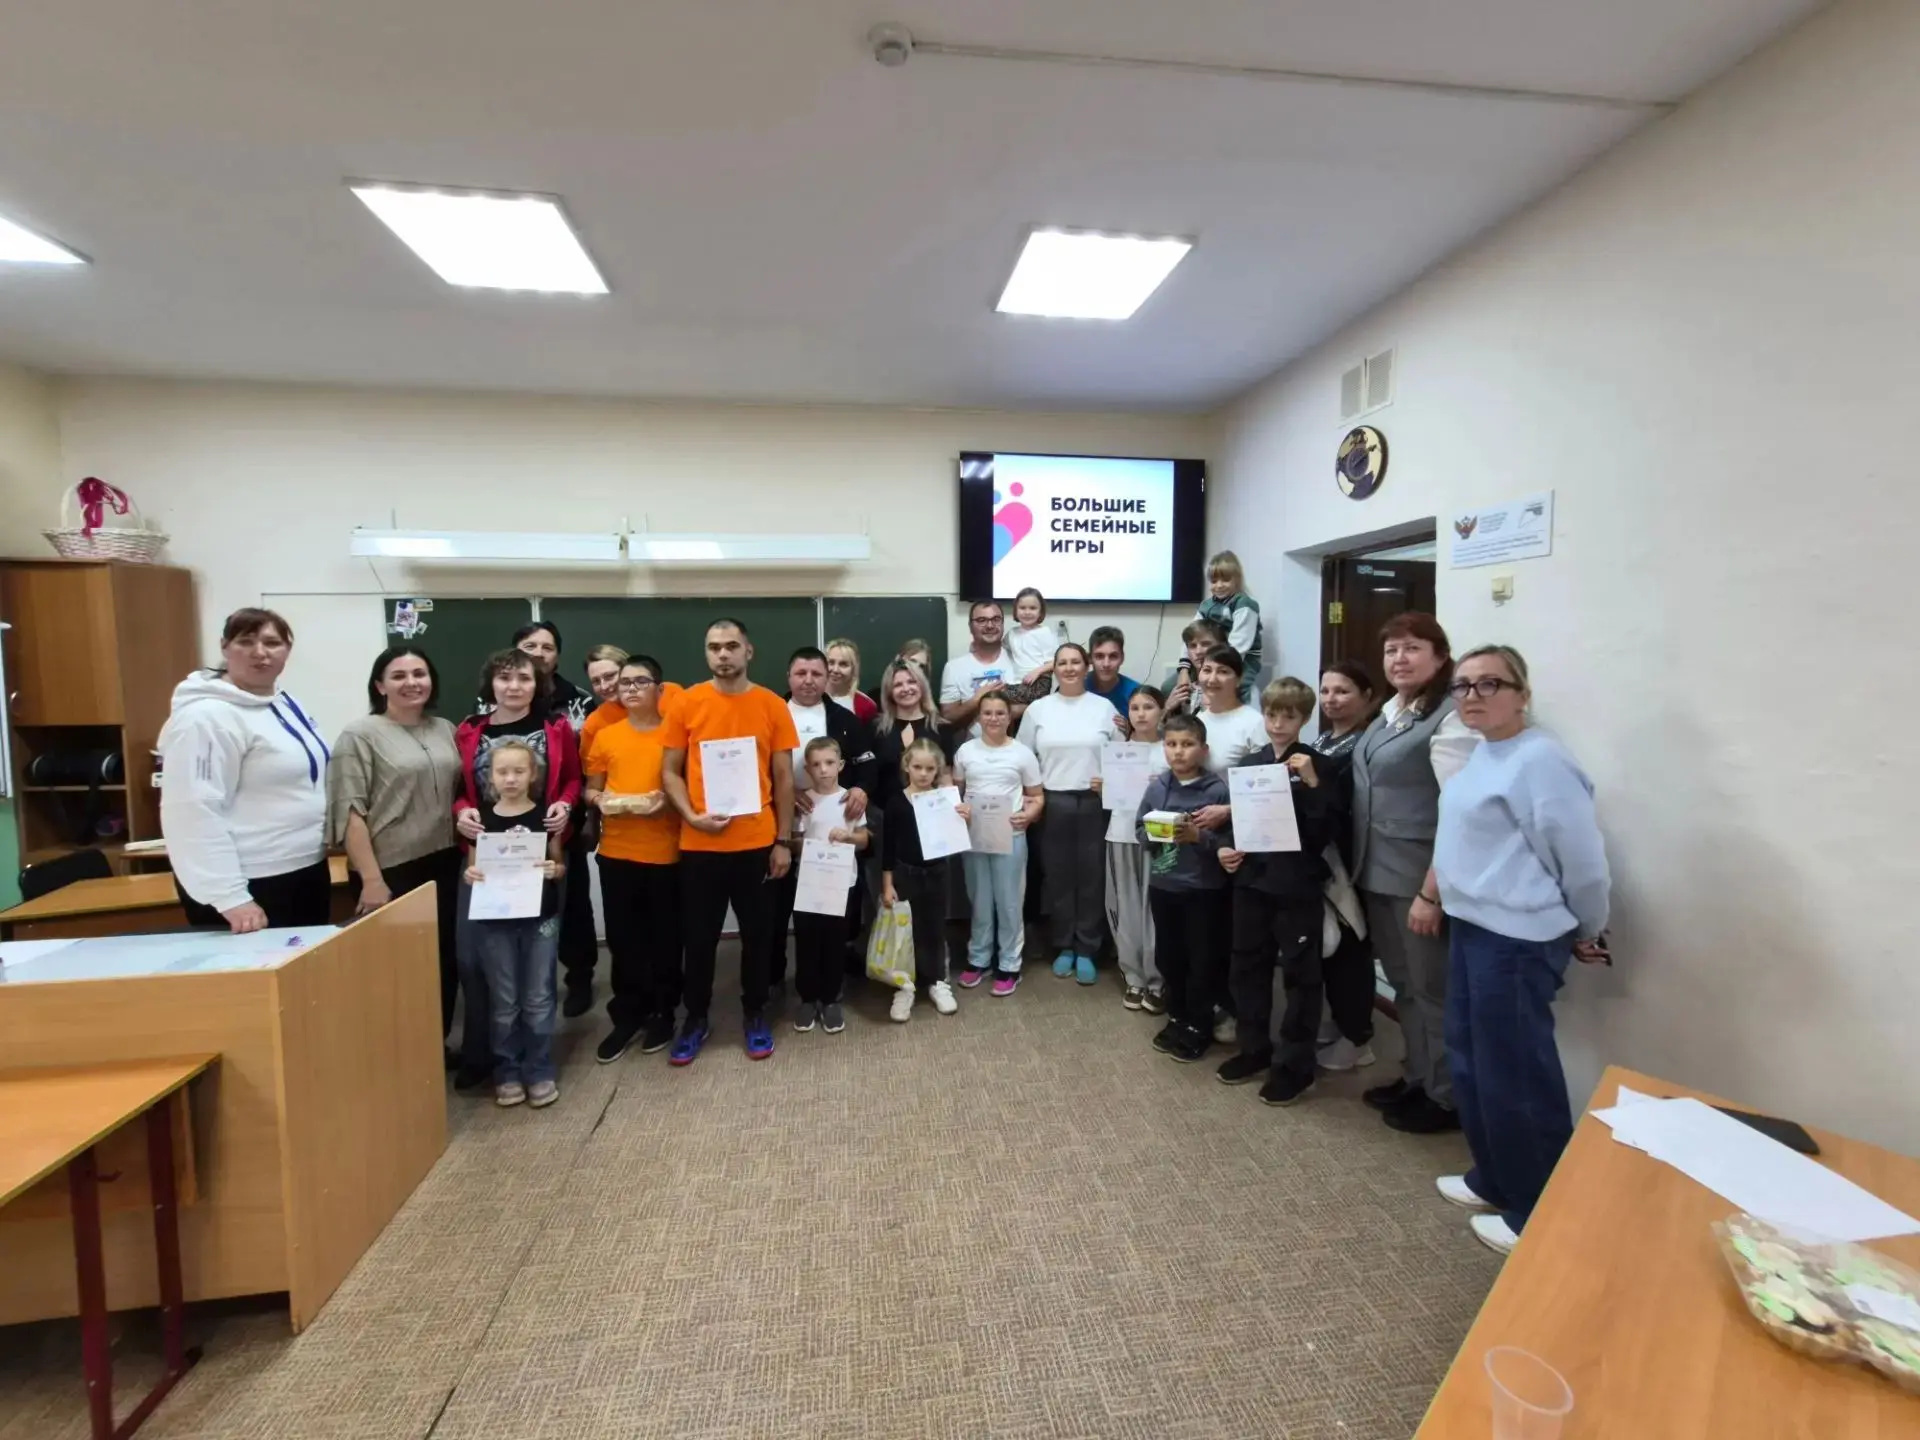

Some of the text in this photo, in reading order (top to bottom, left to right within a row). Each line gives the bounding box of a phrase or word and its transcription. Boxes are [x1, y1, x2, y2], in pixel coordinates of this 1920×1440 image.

[1051, 497, 1146, 513] БОЛЬШИЕ
[1051, 516, 1156, 534] СЕМЕЙНЫЕ
[1051, 539, 1104, 554] ИГРЫ
